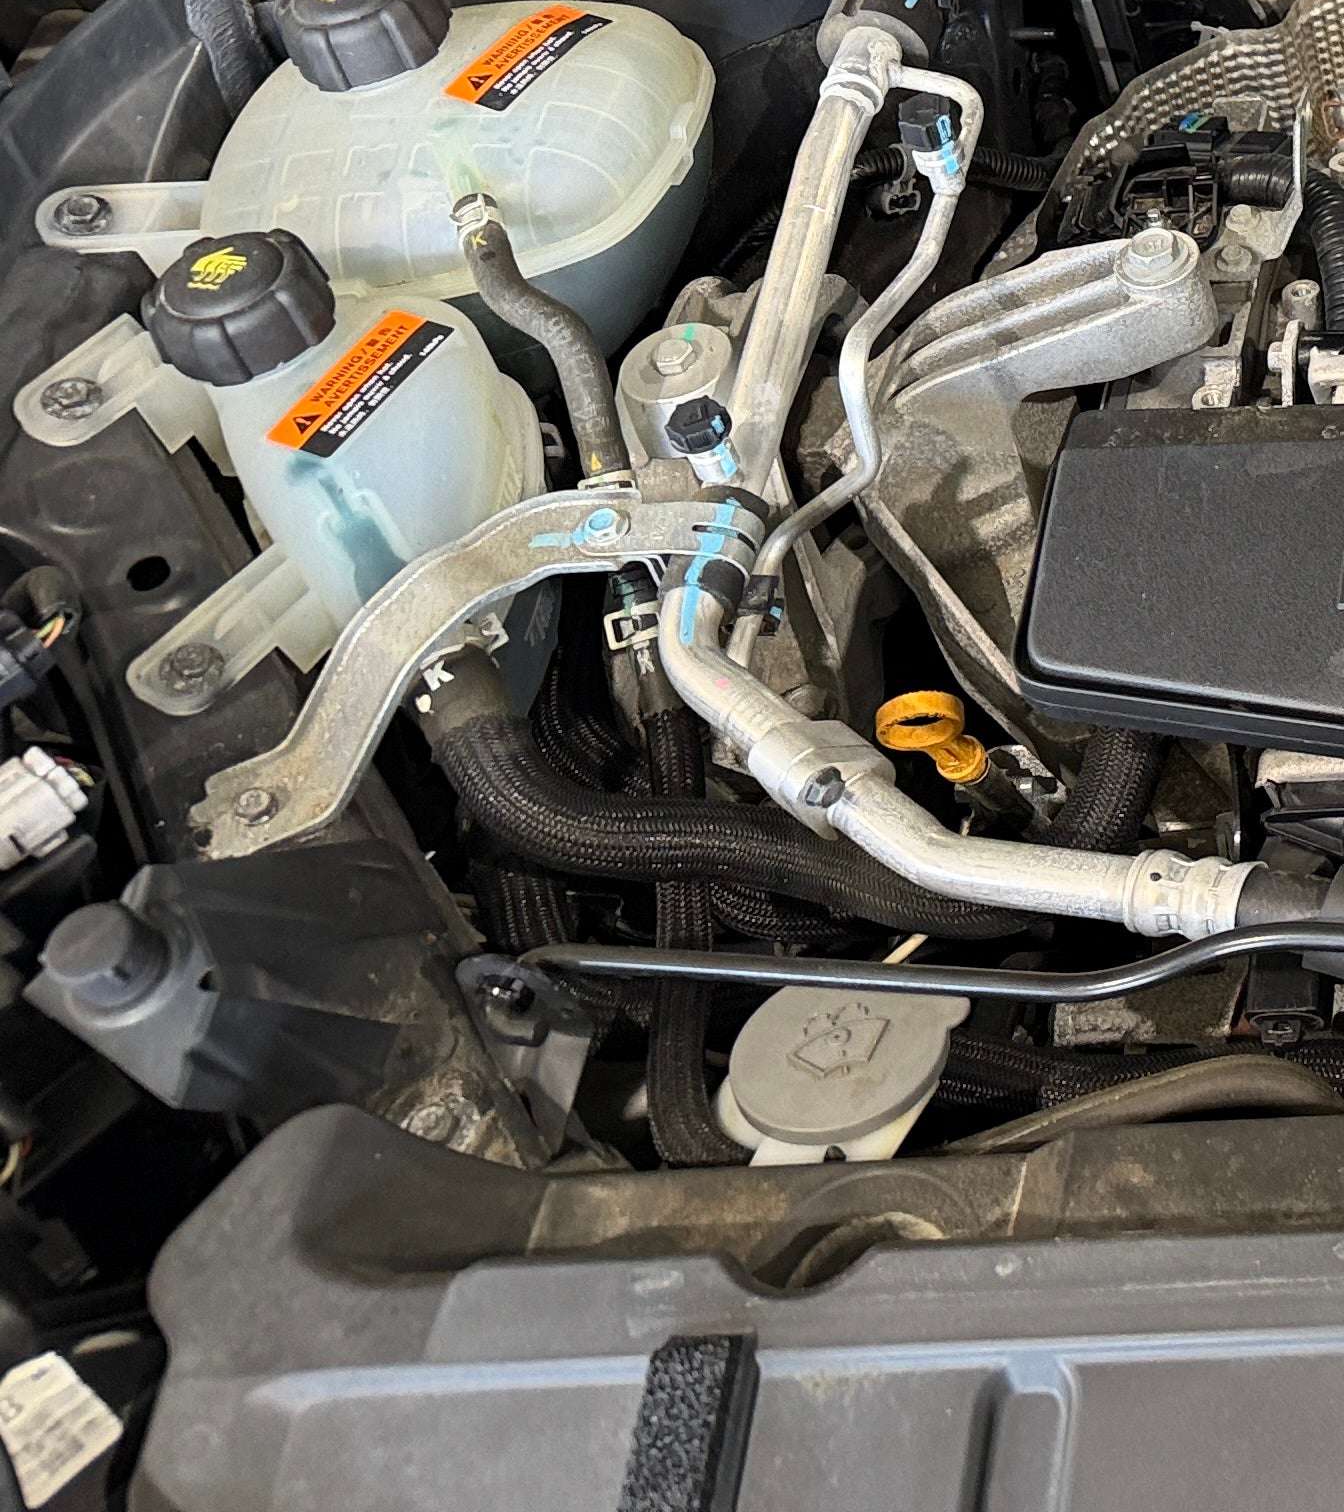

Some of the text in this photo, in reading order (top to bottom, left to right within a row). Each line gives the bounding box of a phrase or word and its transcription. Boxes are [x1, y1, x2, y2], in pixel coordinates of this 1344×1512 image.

[482, 29, 529, 66] WARNING
[495, 14, 570, 70] AVERTISSEMENT
[471, 231, 488, 249] K
[310, 355, 364, 403] WARNING
[324, 325, 409, 408] AVERTISSEMENT
[423, 659, 455, 692] K
